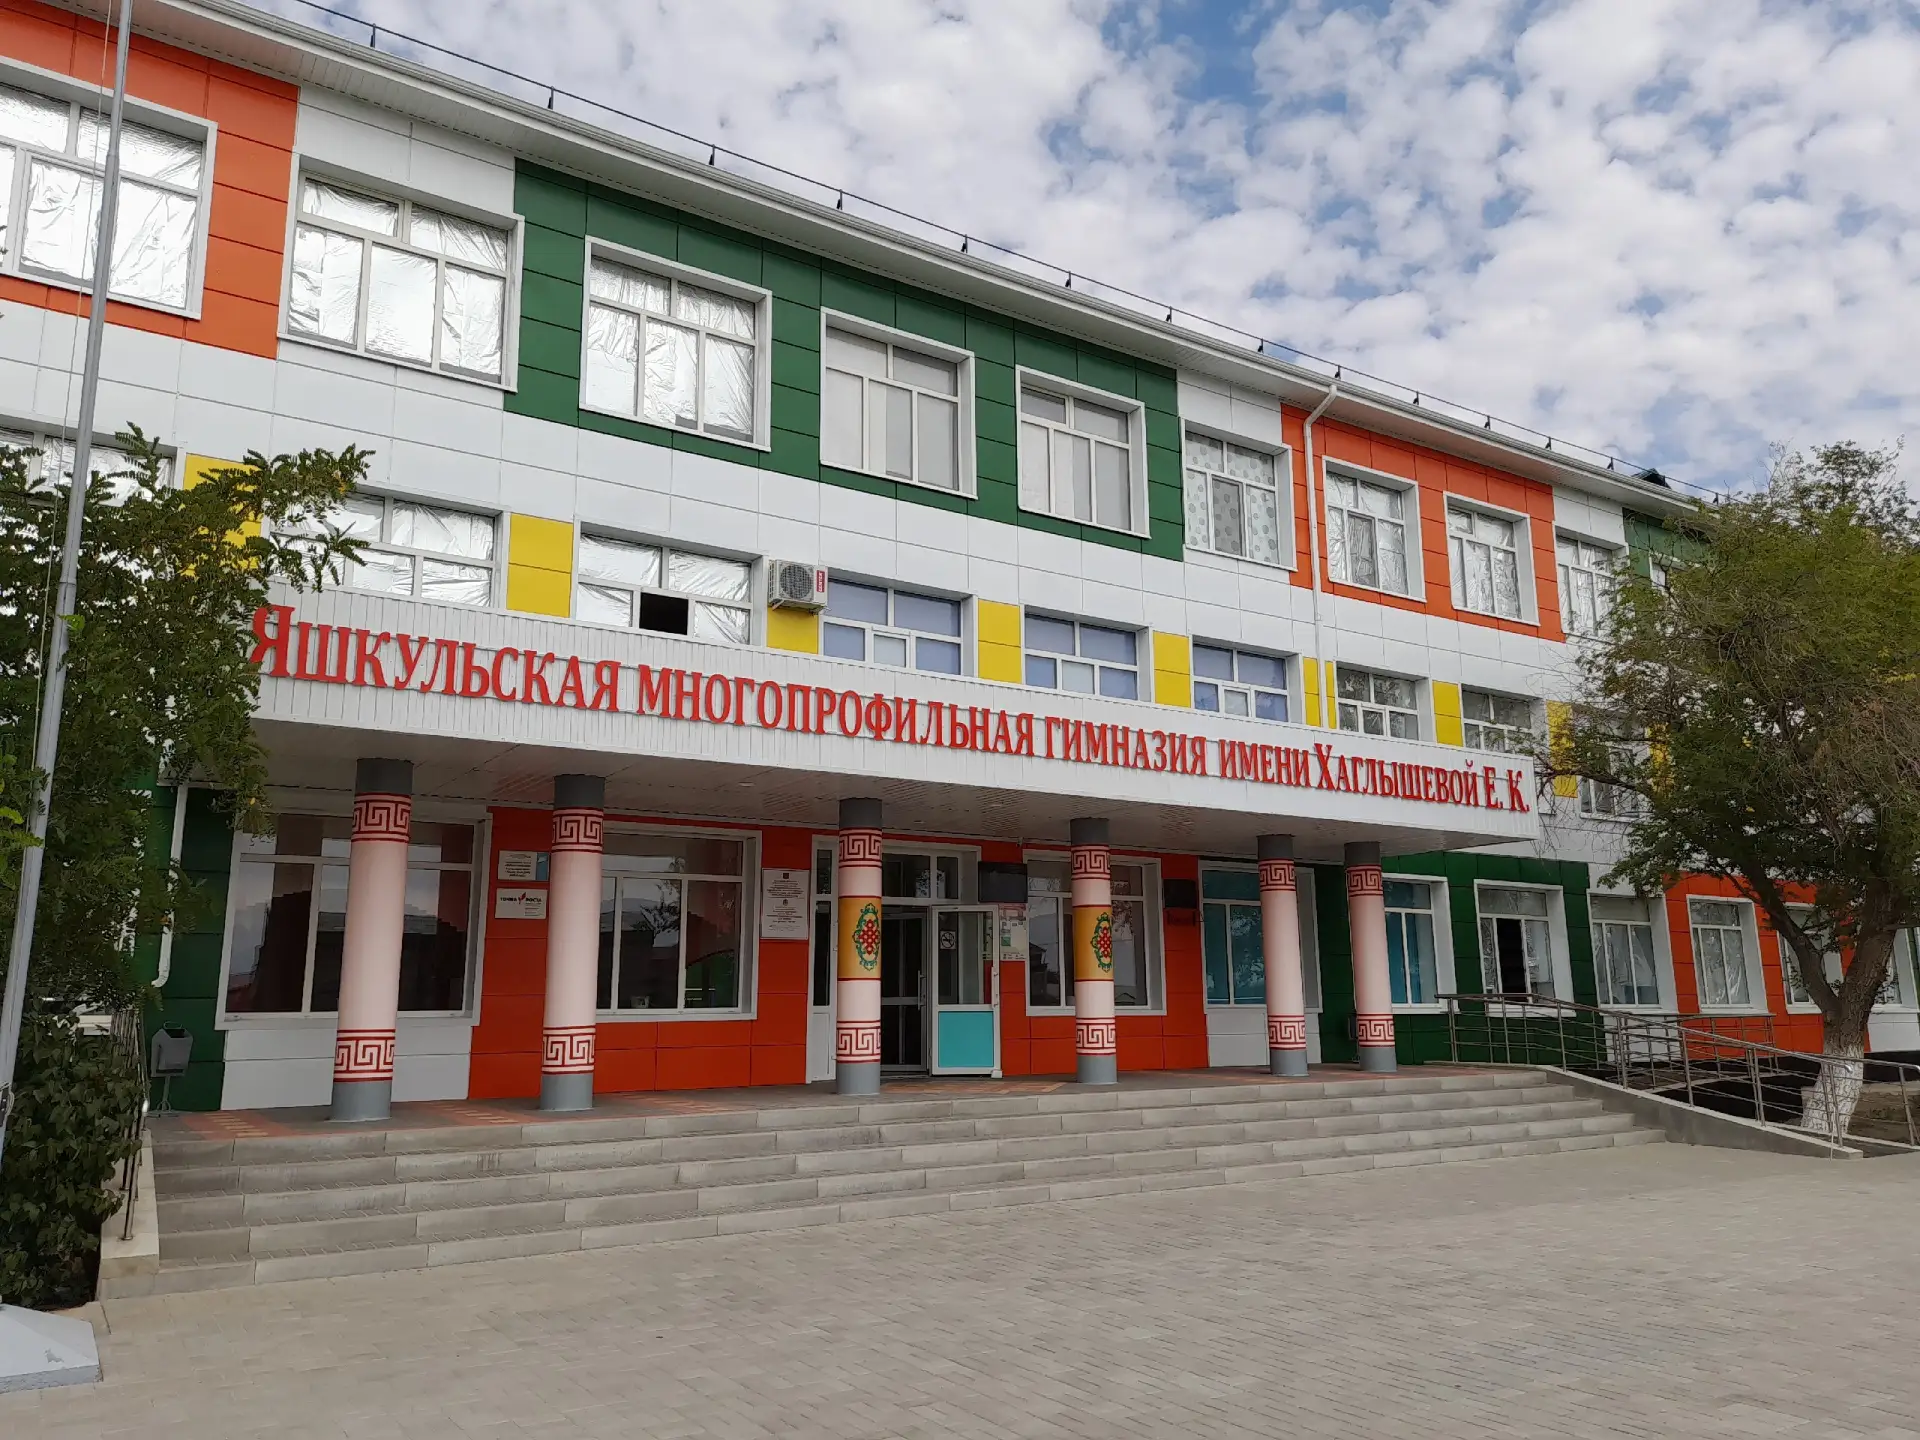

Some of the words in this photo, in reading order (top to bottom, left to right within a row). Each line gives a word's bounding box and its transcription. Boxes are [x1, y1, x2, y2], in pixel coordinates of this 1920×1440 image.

[249, 604, 621, 713] ЯШКУЛЬСКАЯ
[637, 664, 1035, 757] МНОГОПРОФИЛЬНАЯ
[1045, 716, 1207, 777] ГИМНАЗИЯ
[1219, 739, 1311, 788] ИМЕНИ
[1313, 743, 1480, 808] ХАГЛЫШЕВОЙ
